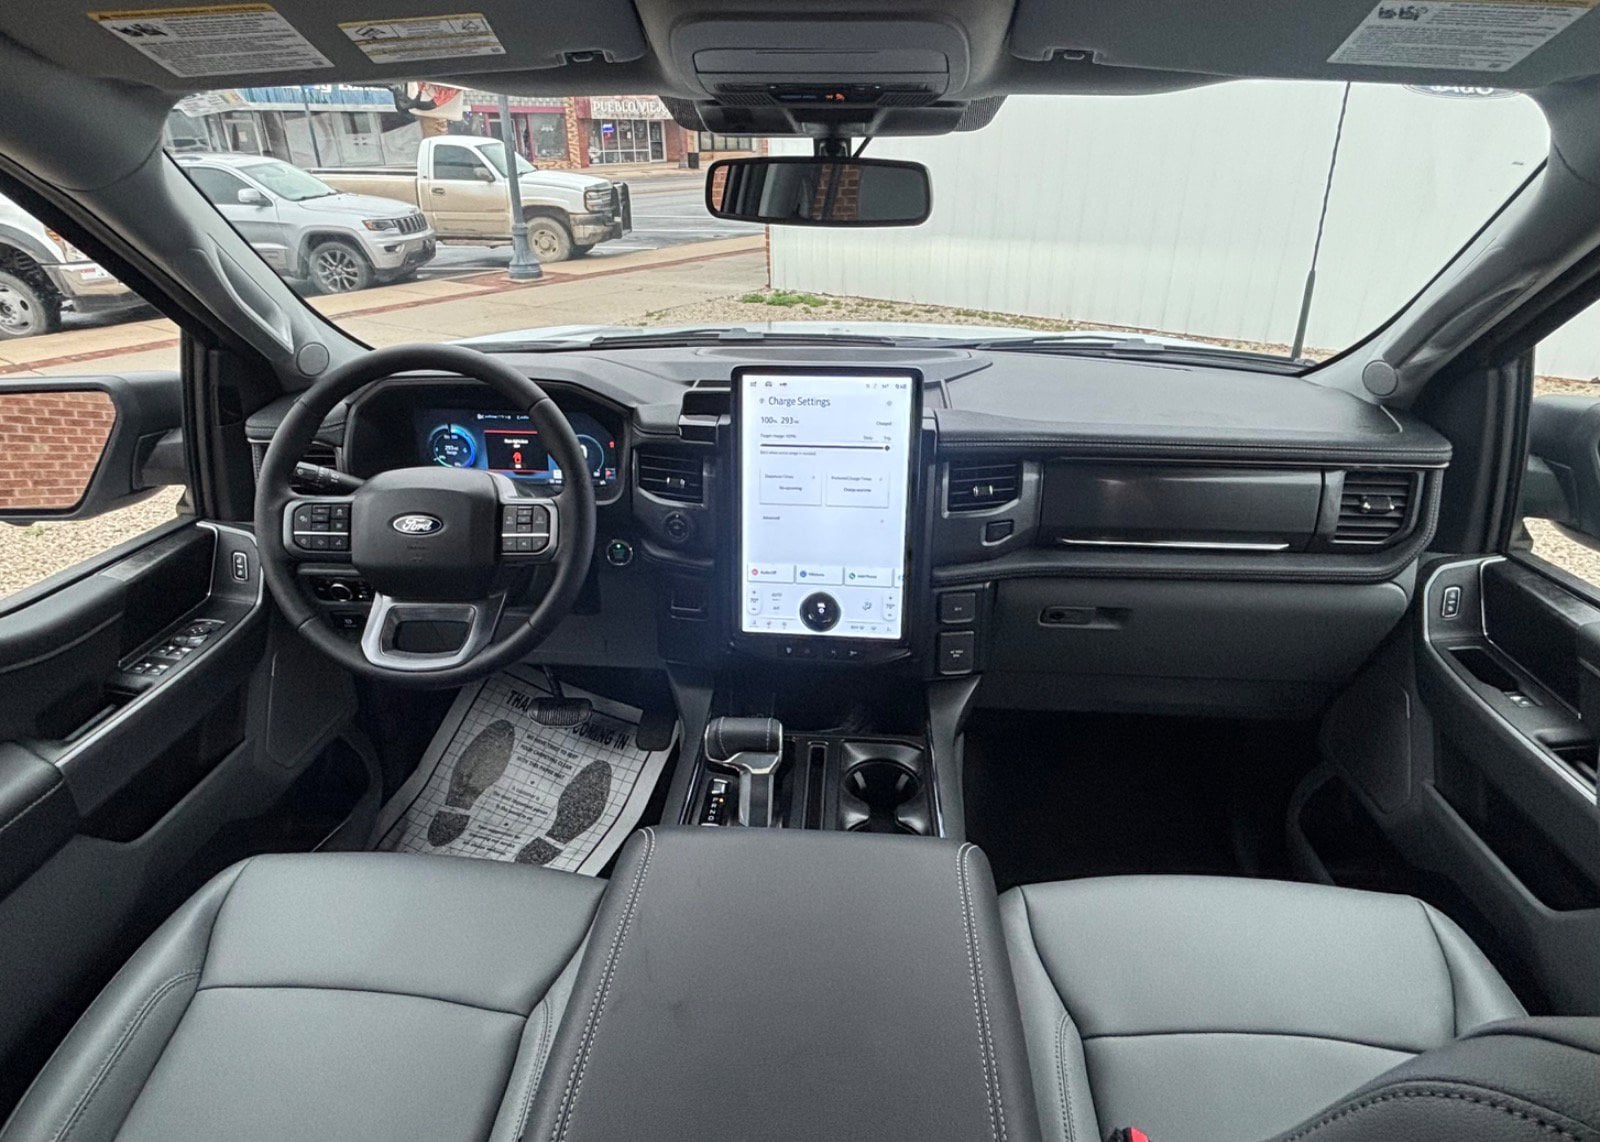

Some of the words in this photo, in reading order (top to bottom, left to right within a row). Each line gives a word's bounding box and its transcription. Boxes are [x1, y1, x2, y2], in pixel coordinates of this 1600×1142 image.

[593, 101, 636, 113] PUEBLO
[768, 396, 796, 408] Charge
[797, 396, 831, 408] Settings
[780, 416, 794, 424] 293
[613, 733, 630, 750] IN
